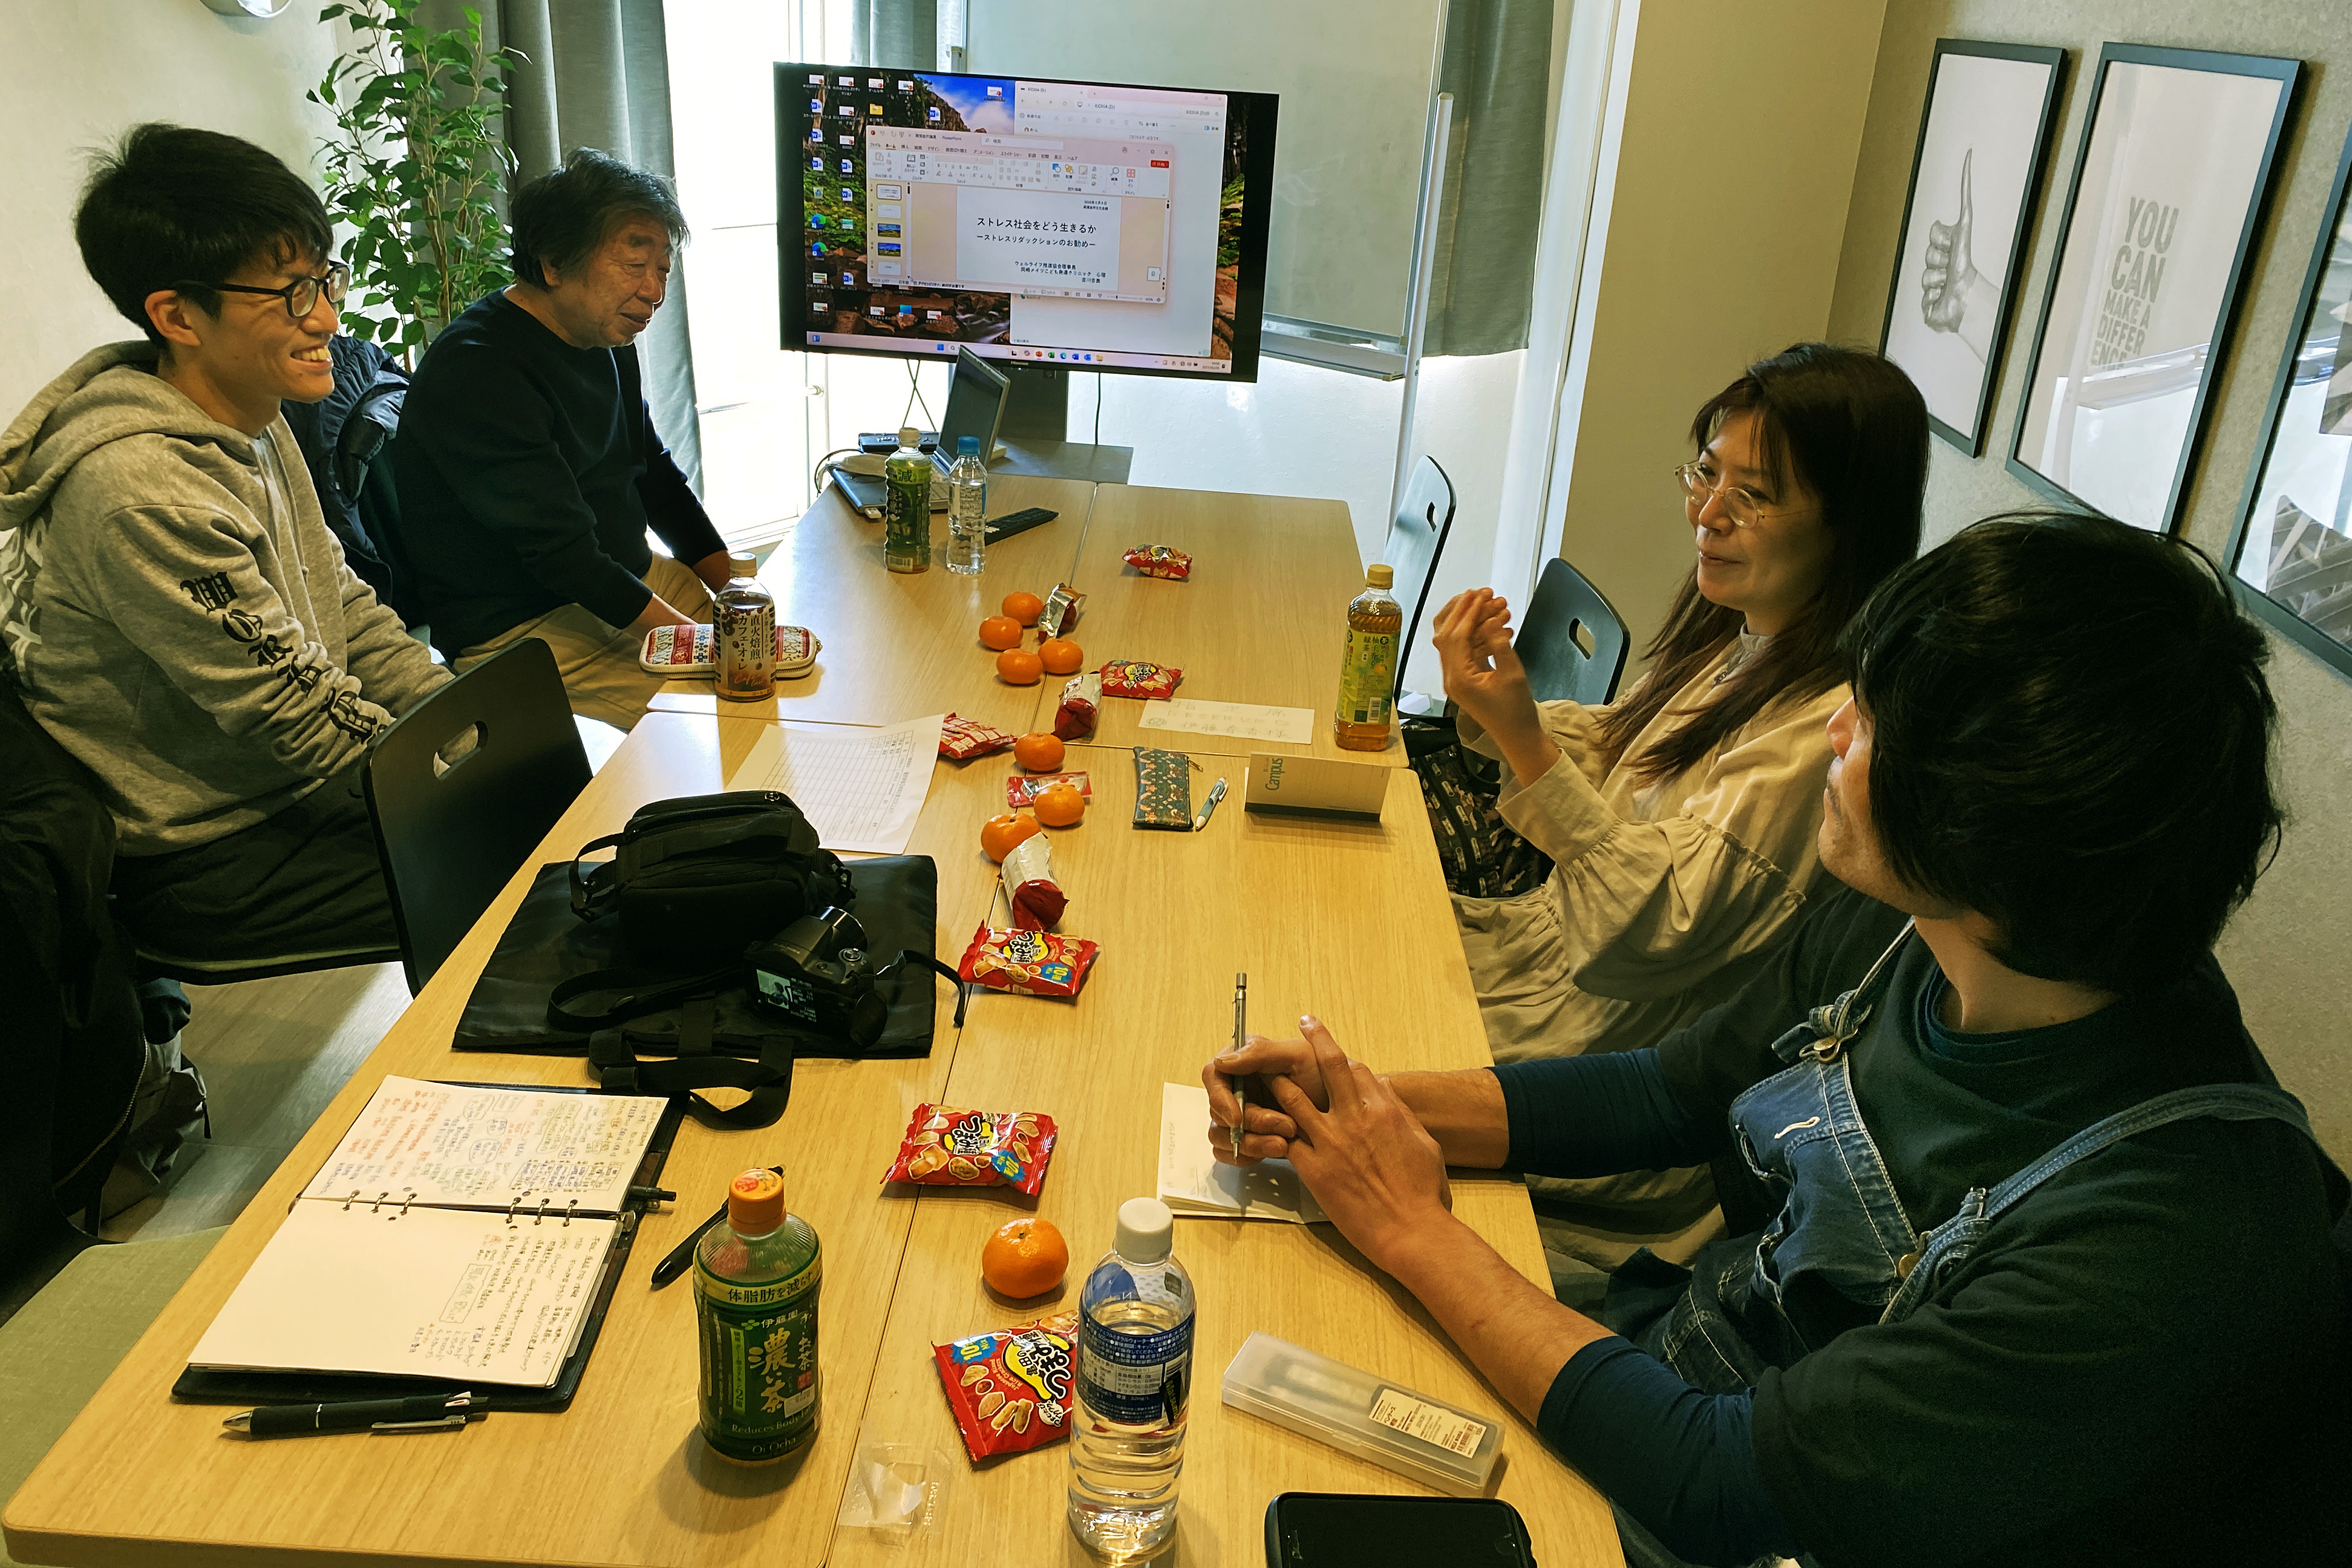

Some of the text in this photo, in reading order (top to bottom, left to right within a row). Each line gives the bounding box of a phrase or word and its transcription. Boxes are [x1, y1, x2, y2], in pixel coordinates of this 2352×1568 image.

[977, 217, 1097, 234] ストレス社会をどう生きるか
[2125, 196, 2180, 254] YOU
[2111, 245, 2166, 303] CAN
[2103, 289, 2151, 330] MAKE A
[2097, 314, 2146, 357] DIFFER
[2090, 339, 2128, 371] ENCE
[737, 615, 749, 670] カフェ・オ・レ
[750, 615, 762, 661] 直火焙煎
[1362, 636, 1371, 652] 緑茶
[1265, 757, 1285, 791] Campus
[727, 1272, 813, 1303] 体脂肪を減らす
[761, 1309, 799, 1328] 伊藤園
[959, 1344, 980, 1361] 10
[1016, 1350, 1039, 1378] 亀田の
[747, 1327, 797, 1414] 濃い茶
[996, 1371, 1020, 1391] Japanese
[732, 1423, 774, 1434] Reduces
[1383, 1406, 1397, 1425] ペンケース
[769, 1437, 796, 1452] Ocha
